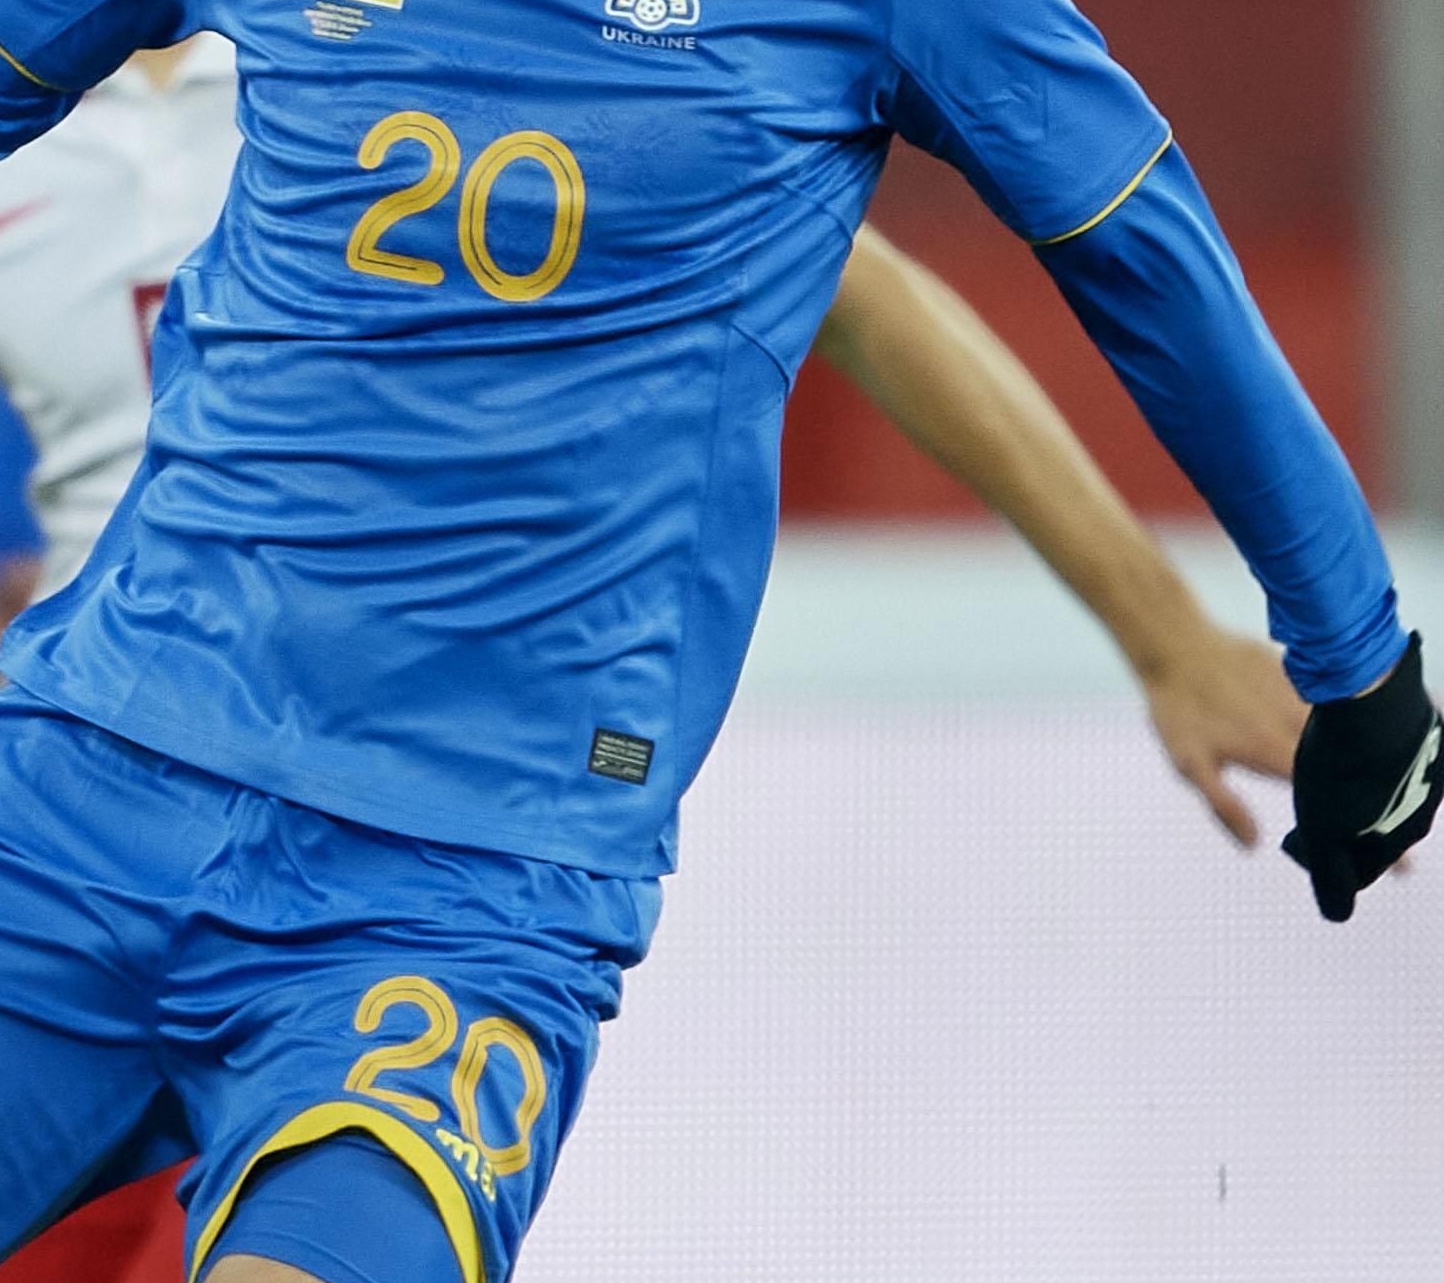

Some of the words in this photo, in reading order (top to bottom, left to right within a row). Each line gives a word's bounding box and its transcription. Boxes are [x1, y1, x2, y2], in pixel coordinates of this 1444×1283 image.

[601, 24, 697, 51] UKRAINE
[346, 110, 586, 303] 20
[343, 974, 547, 1177] 20
